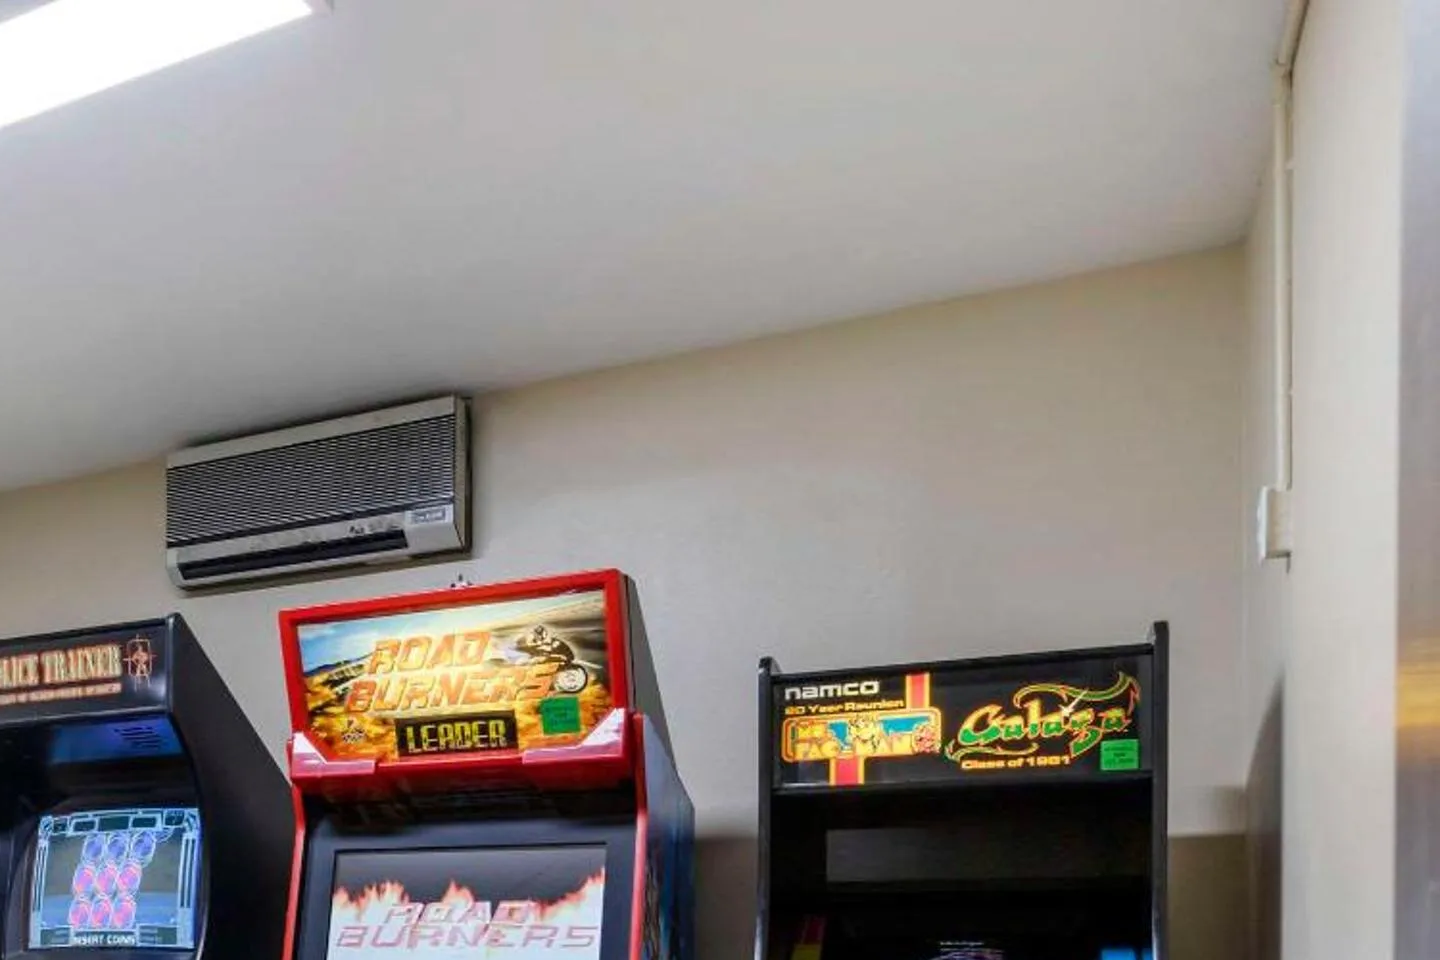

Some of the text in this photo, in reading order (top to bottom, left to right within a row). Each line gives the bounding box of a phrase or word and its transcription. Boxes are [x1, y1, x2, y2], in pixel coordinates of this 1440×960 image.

[41, 644, 122, 685] TRAINER
[366, 628, 491, 676] ROAD
[344, 661, 560, 714] BURNERS
[785, 680, 880, 701] namco
[808, 703, 844, 714] Year
[844, 699, 905, 712] Reunion
[405, 717, 508, 754] LEADER
[957, 698, 1131, 758] Galaga
[960, 755, 1071, 770] Class of 1981
[383, 899, 534, 925] ROAD
[73, 933, 105, 946] INSERT
[336, 925, 599, 949] BURNERS
